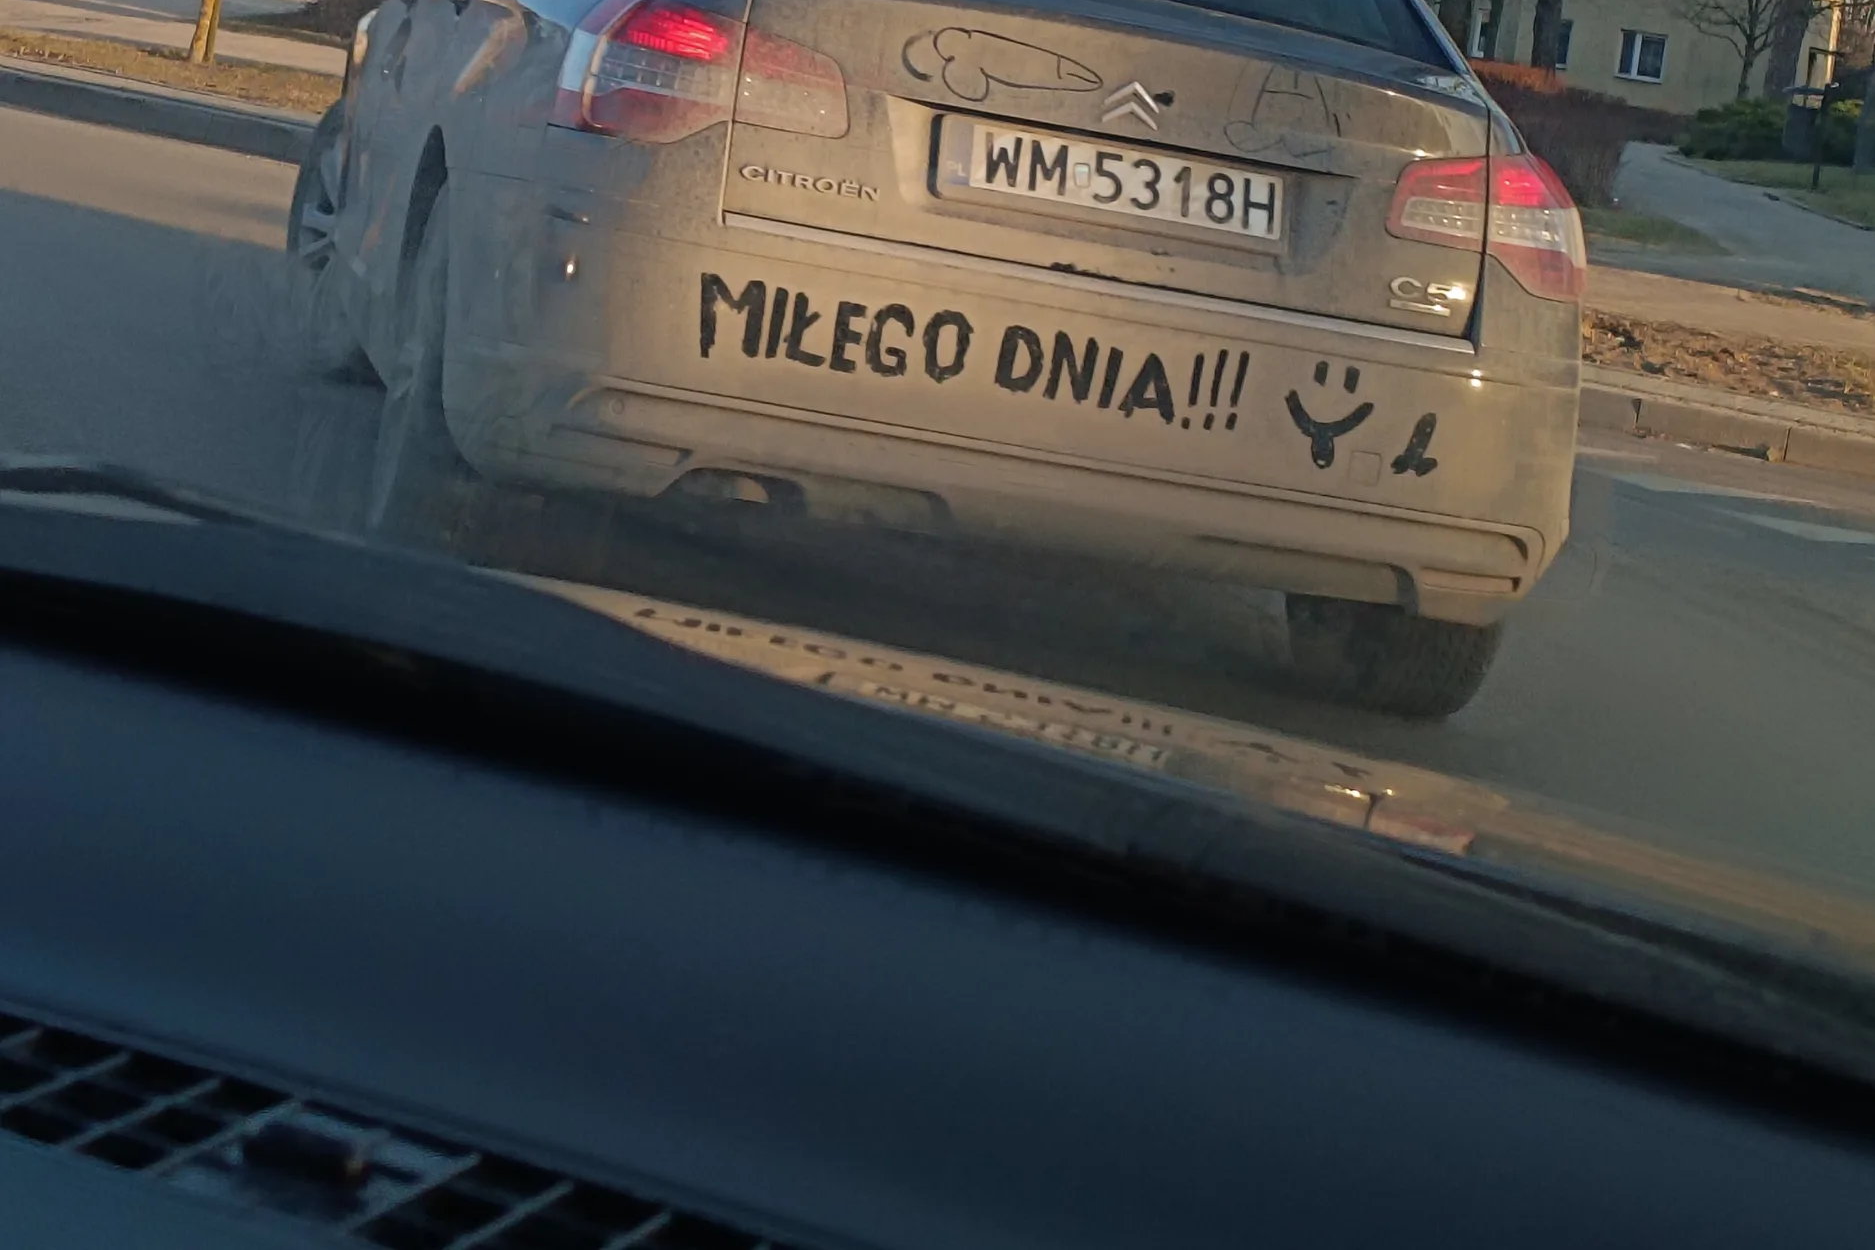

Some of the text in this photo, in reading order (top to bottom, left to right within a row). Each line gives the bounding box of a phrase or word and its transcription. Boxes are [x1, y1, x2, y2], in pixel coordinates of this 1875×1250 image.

[740, 164, 881, 202] CITROËN
[946, 160, 967, 177] PL
[985, 131, 1276, 235] WM 5318H
[1389, 276, 1466, 303] C5
[700, 272, 1250, 431] MIŁEGO DNIA!!!
